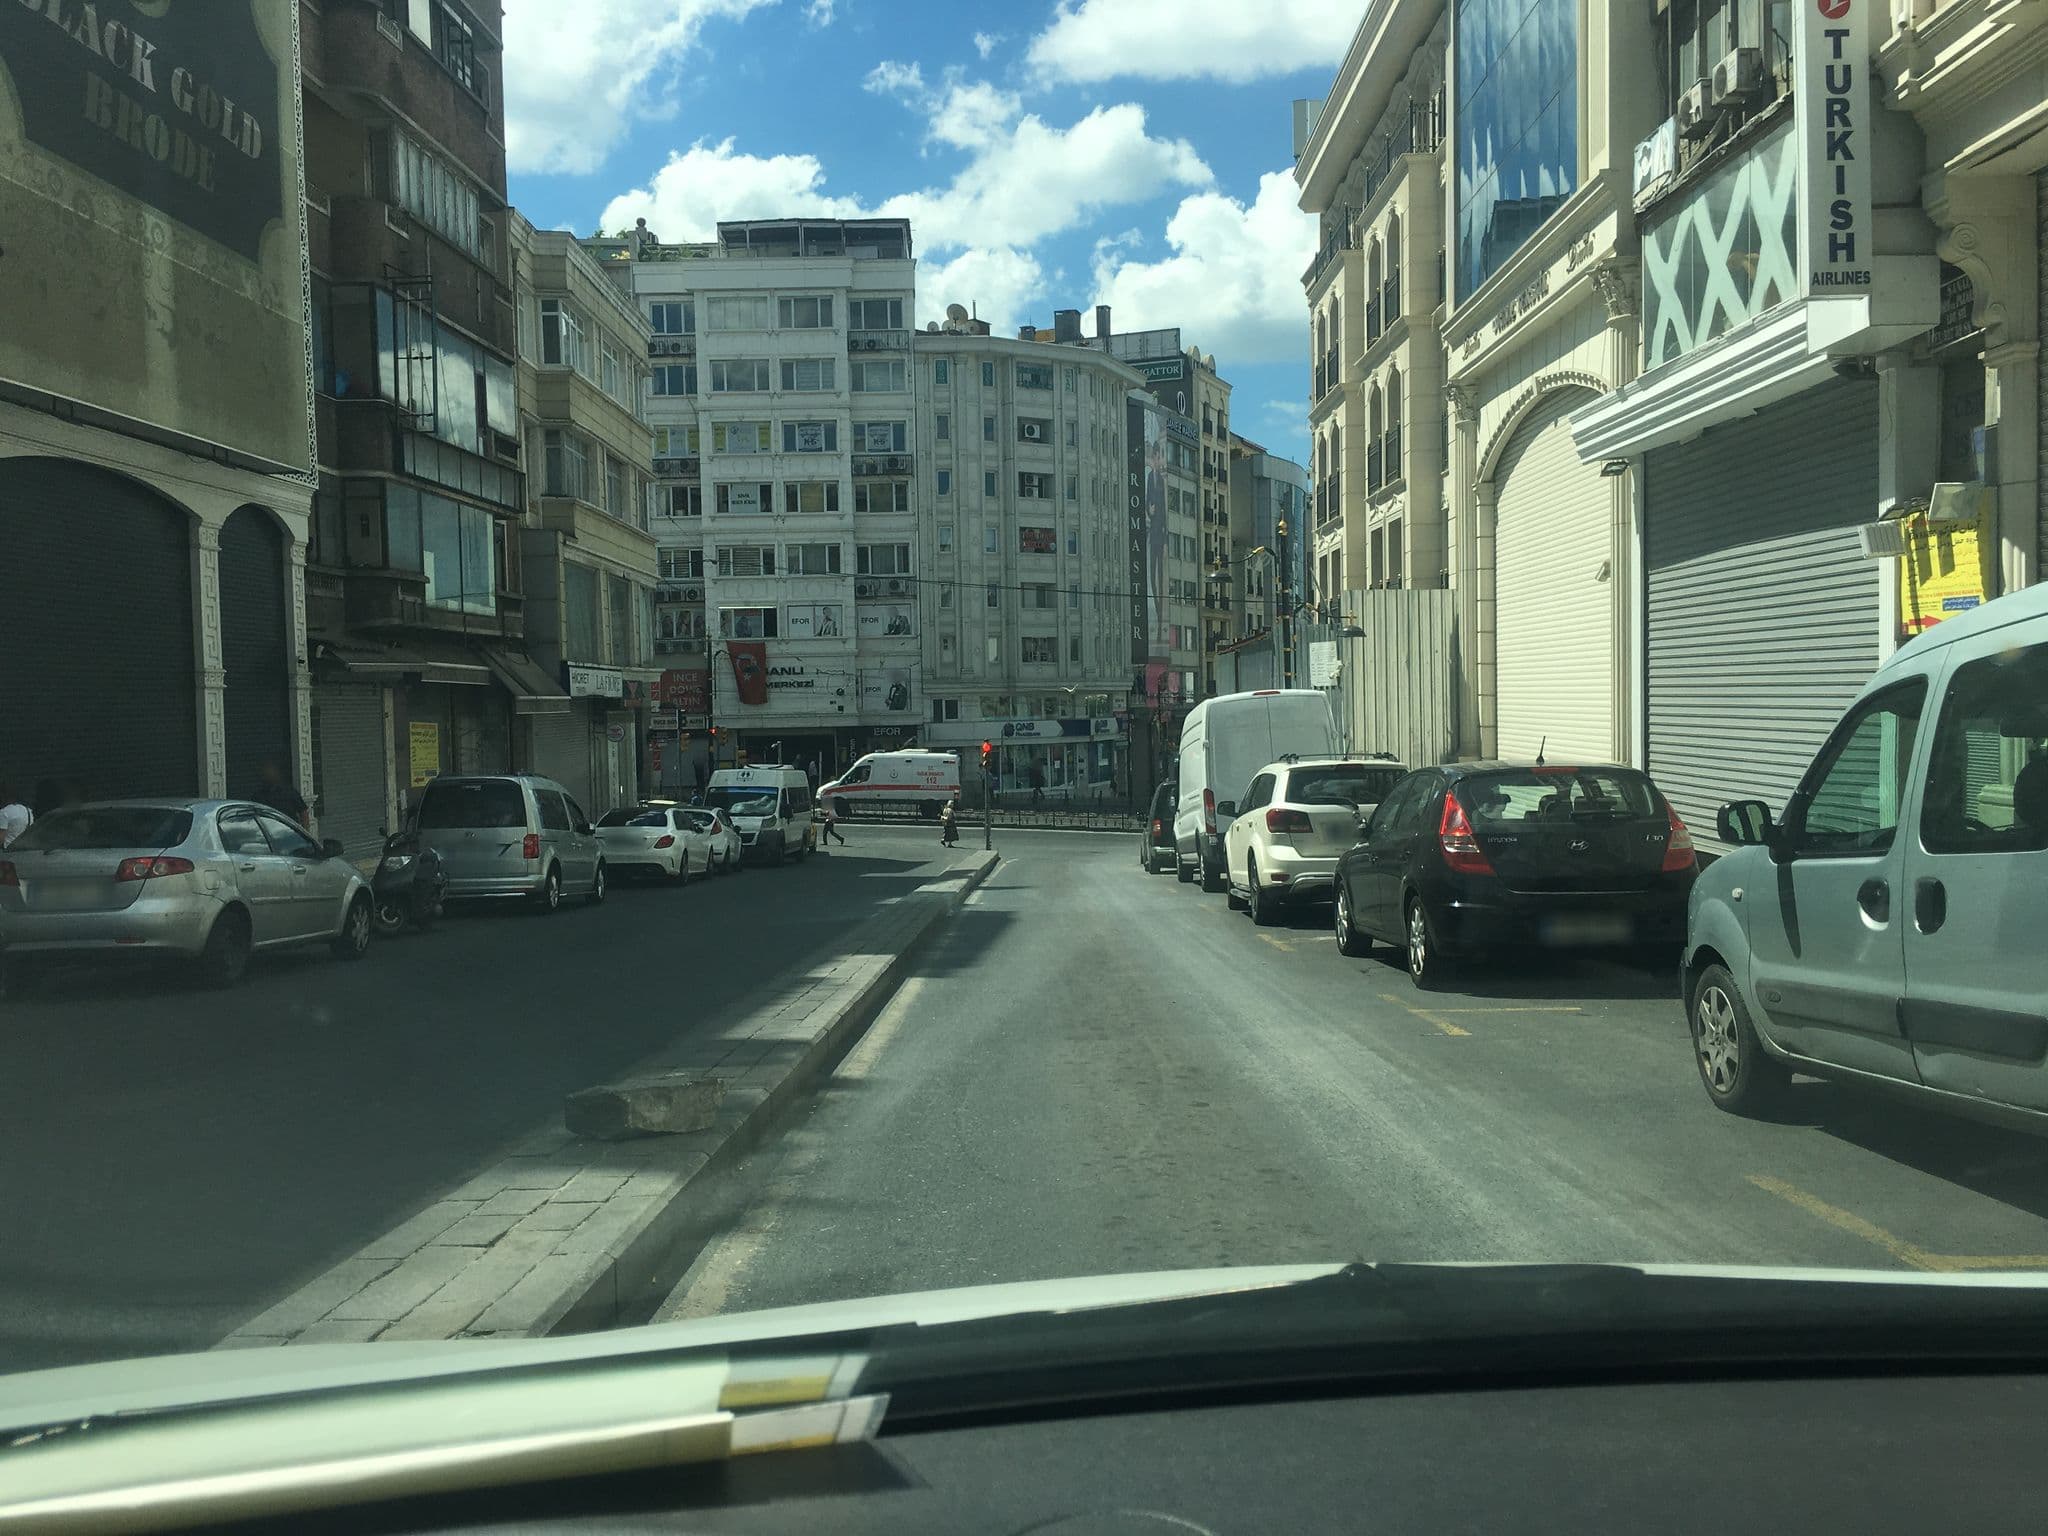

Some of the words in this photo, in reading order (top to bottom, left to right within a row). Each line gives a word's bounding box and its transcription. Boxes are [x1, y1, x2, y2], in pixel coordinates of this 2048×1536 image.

[18, 0, 157, 94] LACK
[170, 66, 262, 159] GOLD
[84, 71, 217, 192] BRODE
[1823, 28, 1856, 263] TURKISH
[1811, 270, 1872, 286] AIRLINES
[791, 617, 810, 625] EFOR
[873, 727, 901, 736] EFOR
[1015, 722, 1035, 731] QNB
[926, 776, 937, 785] 112
